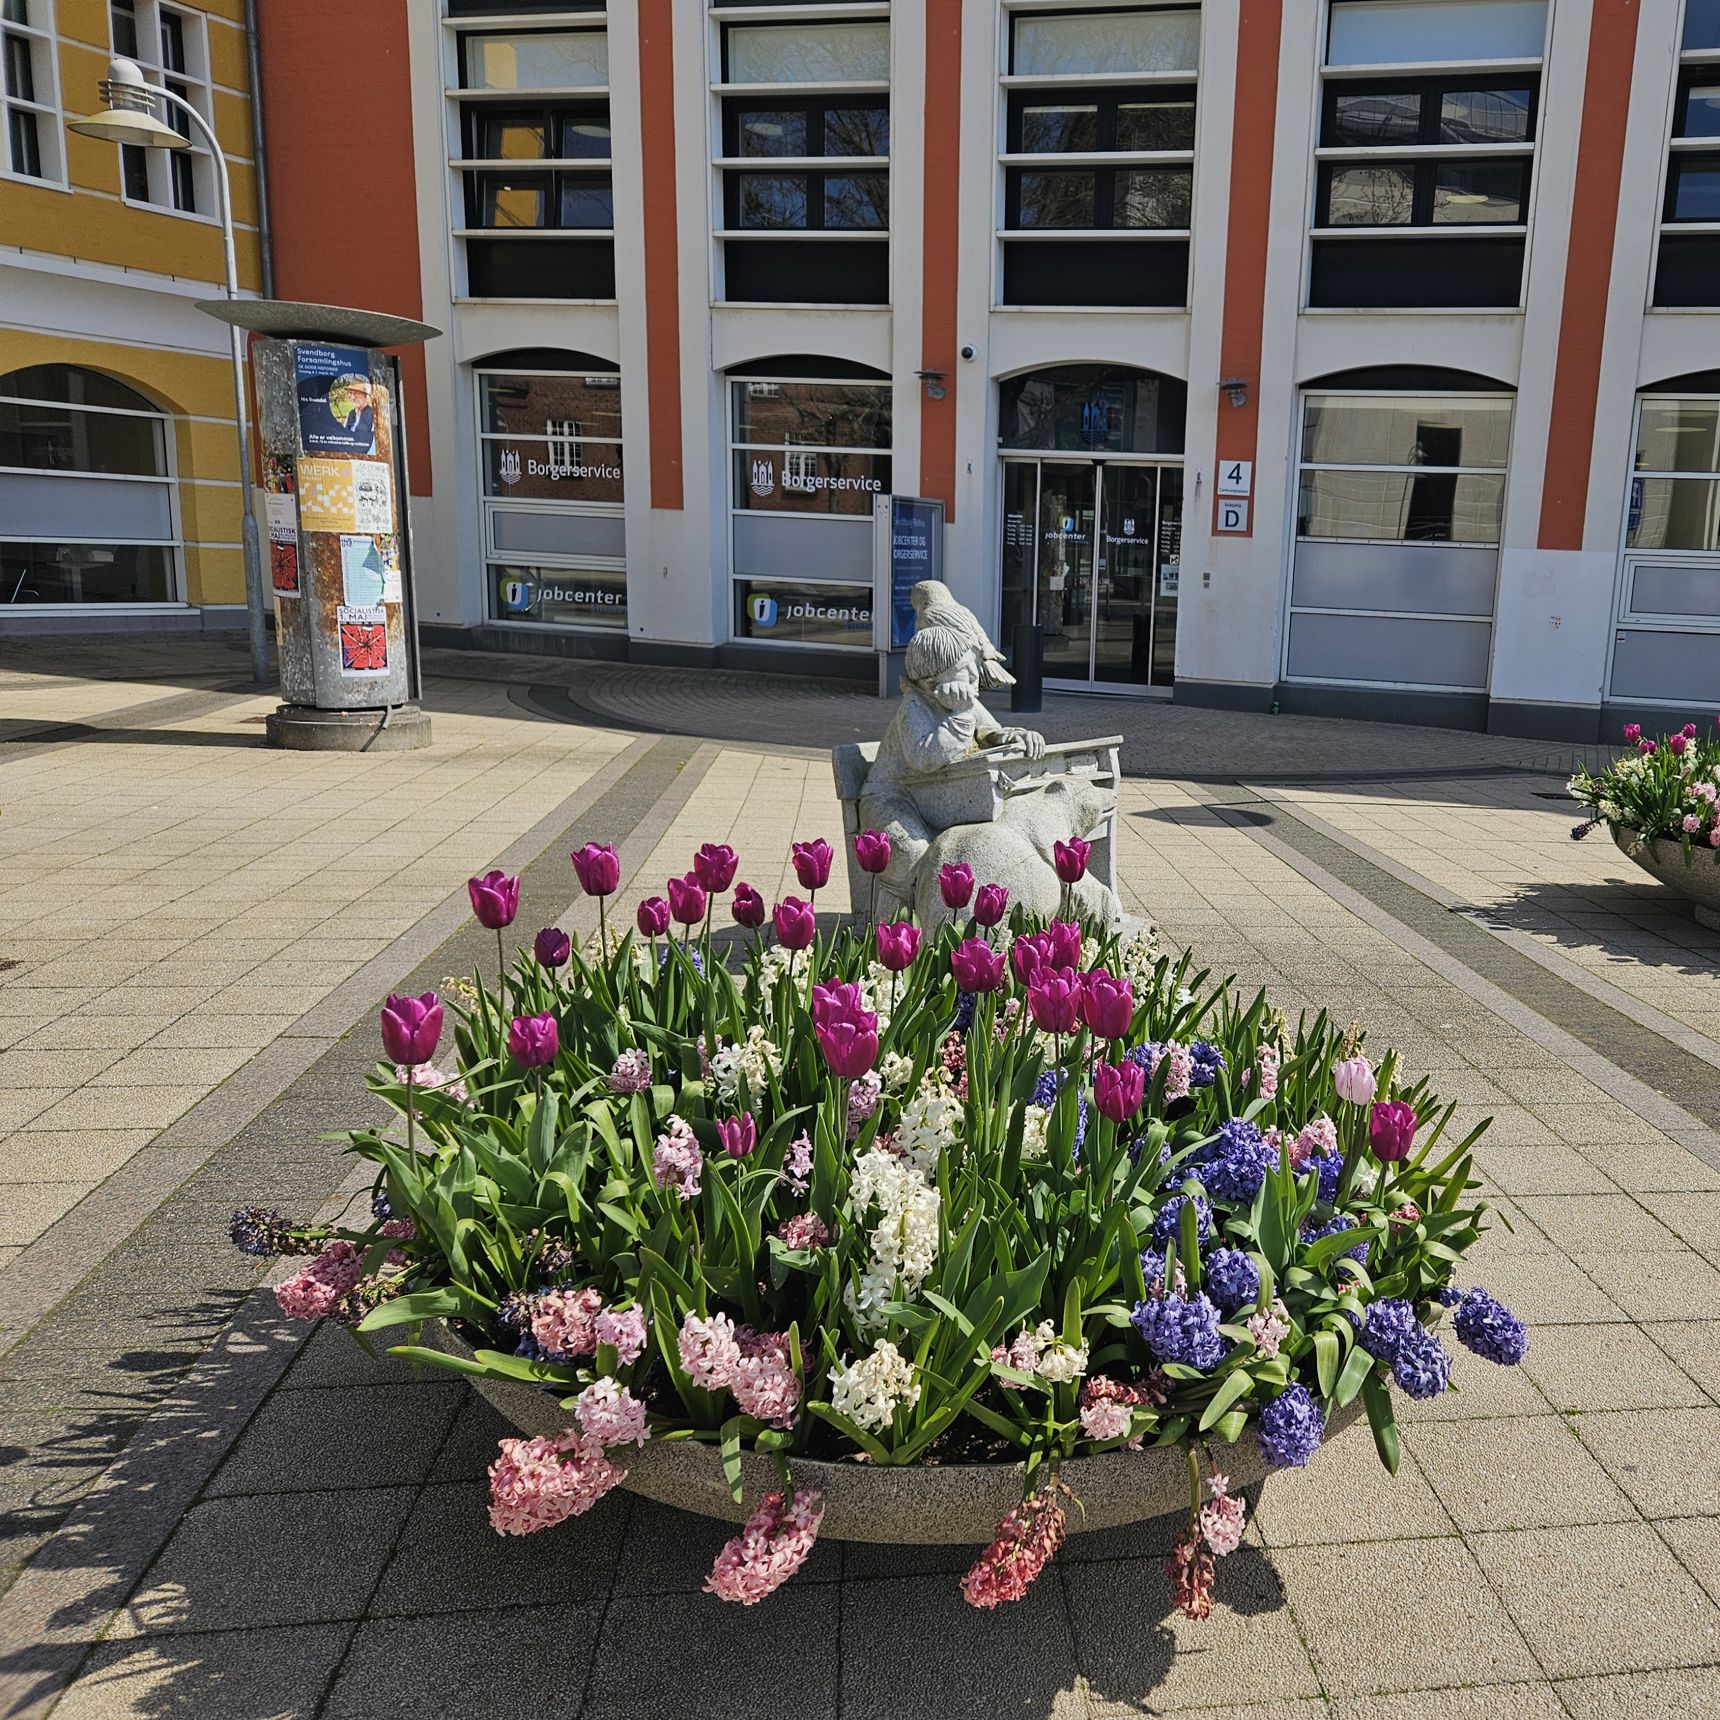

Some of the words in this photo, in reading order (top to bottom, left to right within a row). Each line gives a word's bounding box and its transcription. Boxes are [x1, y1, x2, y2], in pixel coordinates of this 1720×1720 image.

[297, 348, 335, 358] Svendborg
[297, 355, 351, 367] Forsamlingshus
[300, 464, 340, 477] WERK
[528, 459, 621, 480] Borgerservice
[1227, 463, 1242, 485] 4
[781, 470, 882, 493] Borgerservice
[1225, 510, 1240, 528] D
[1045, 531, 1087, 540] jobcenter
[1106, 535, 1149, 545] Borgerservice
[537, 585, 622, 605] jobcenter
